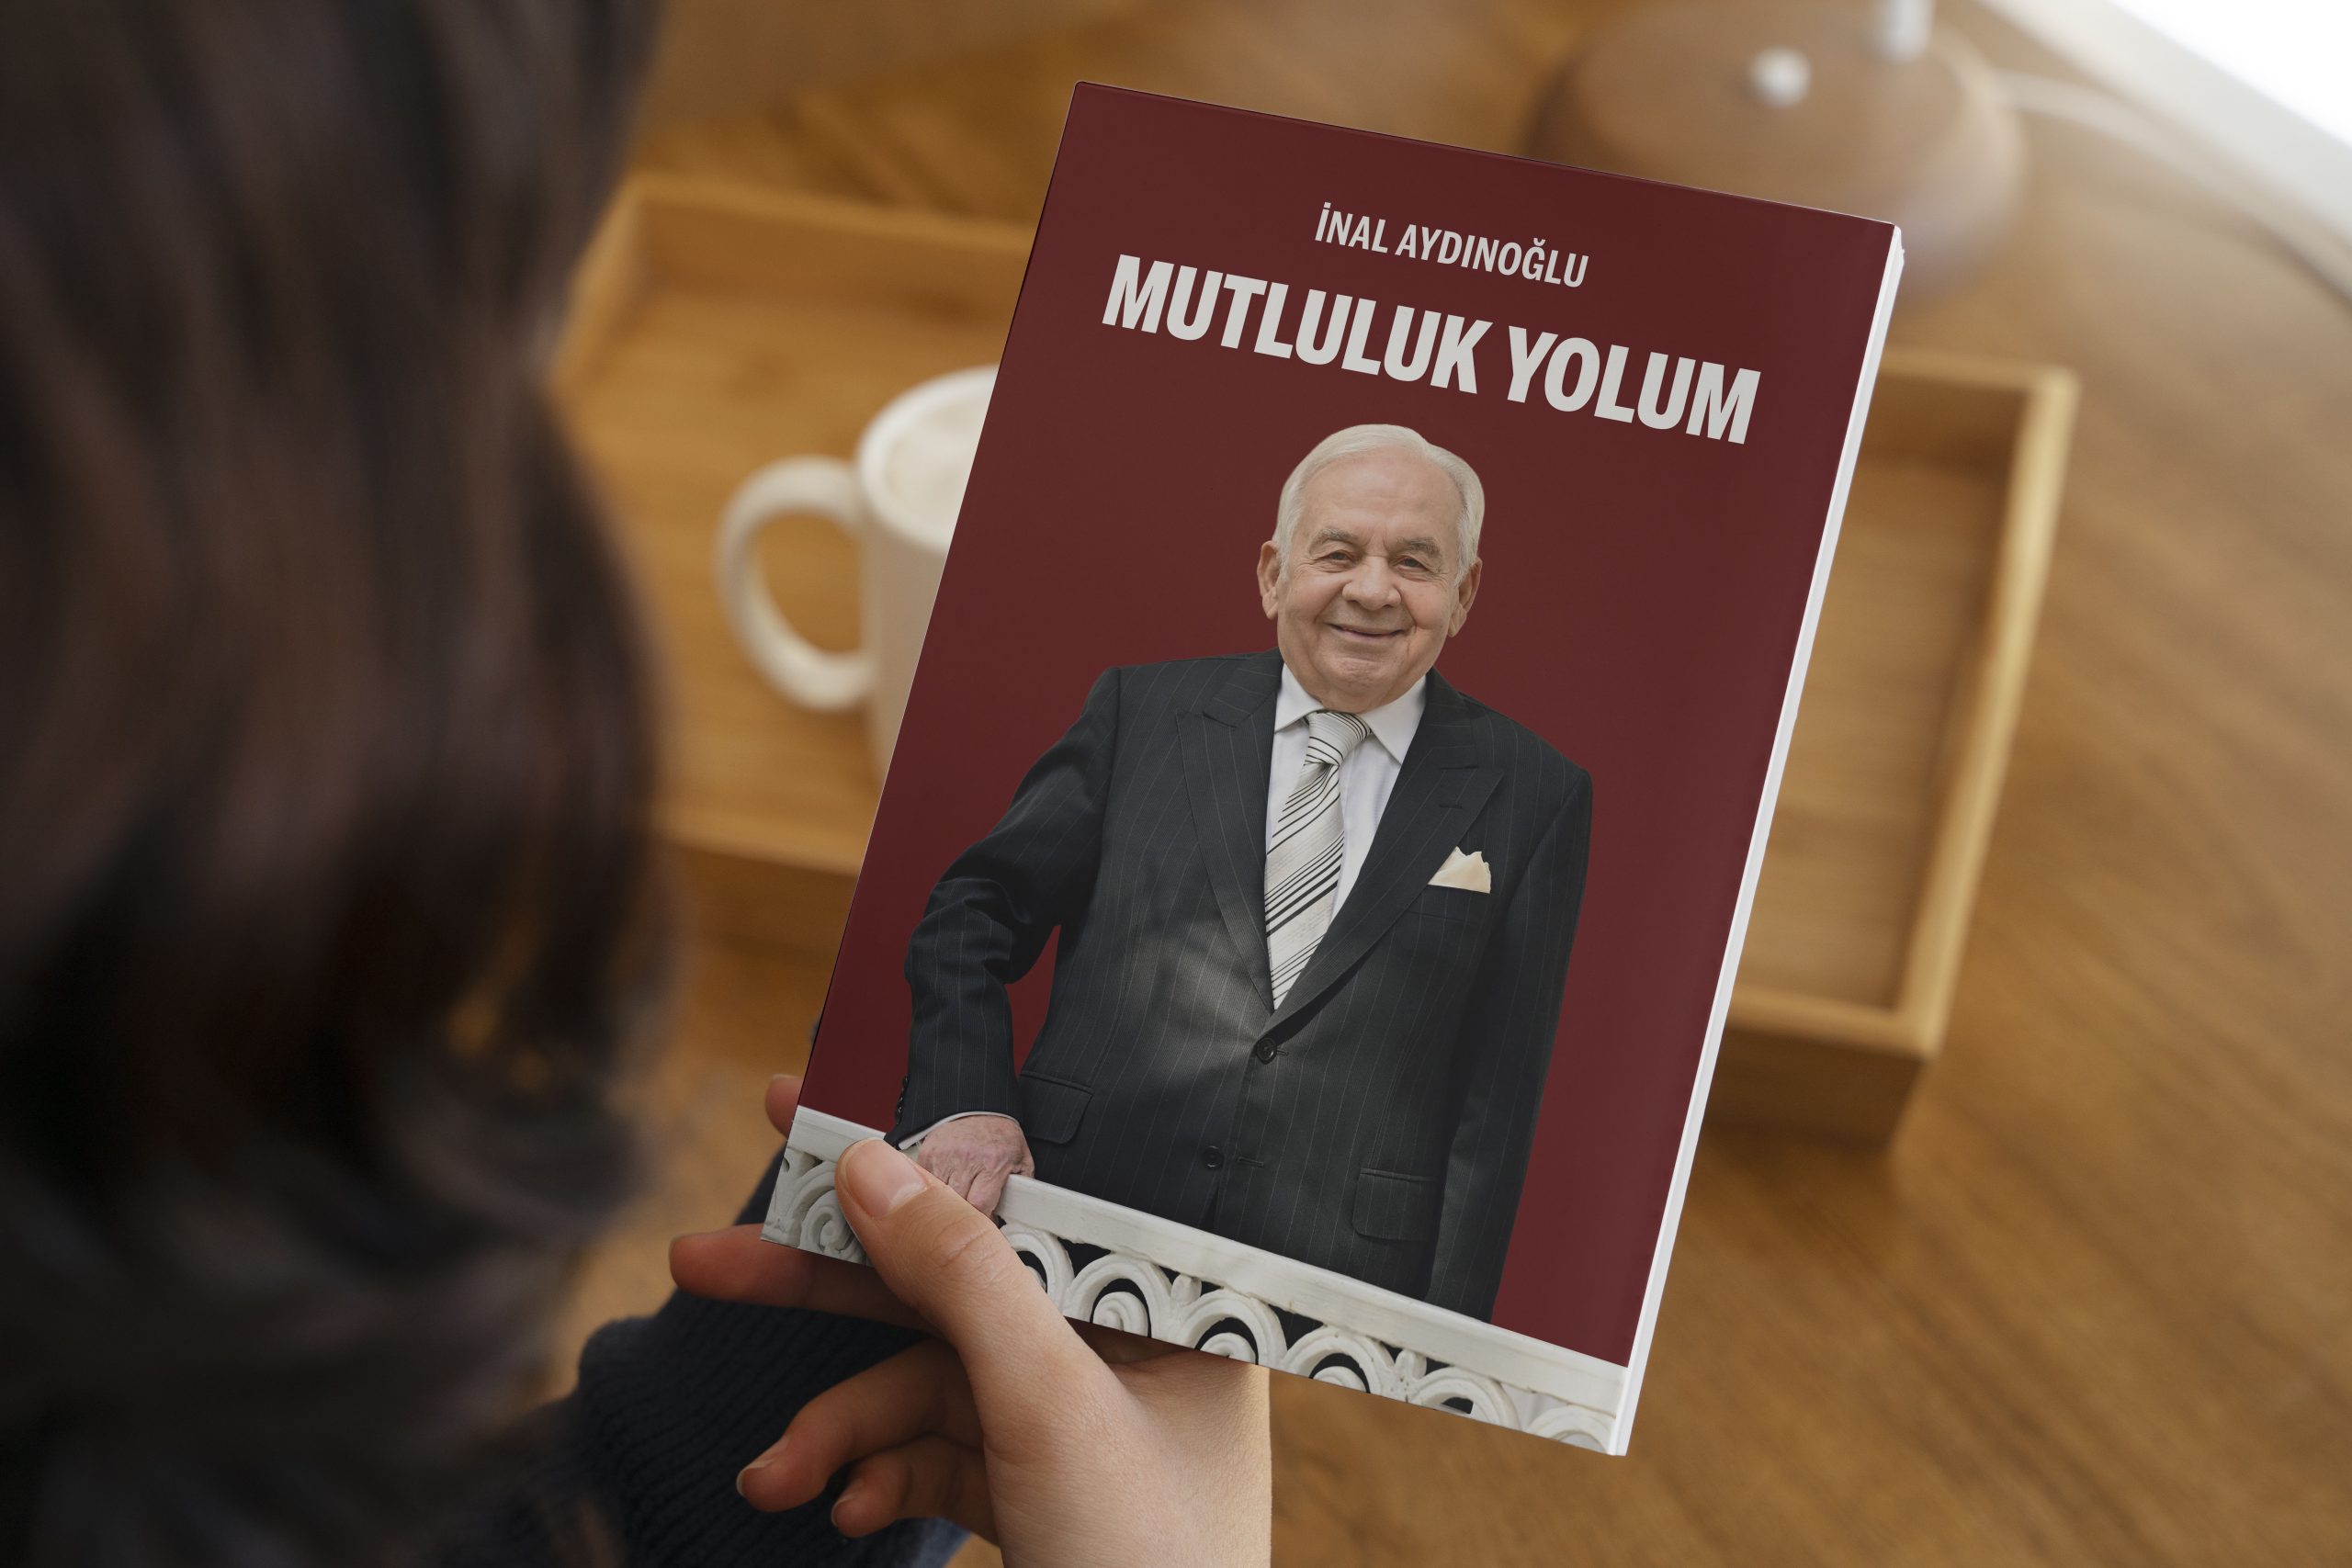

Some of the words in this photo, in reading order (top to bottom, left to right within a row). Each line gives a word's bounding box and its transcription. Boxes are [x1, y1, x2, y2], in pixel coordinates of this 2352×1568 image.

[1315, 202, 1388, 254] İNAL
[1395, 225, 1589, 288] AYDINOĞLU
[1102, 254, 1493, 394] MUTLULUK
[1507, 325, 1761, 445] YOLUM
